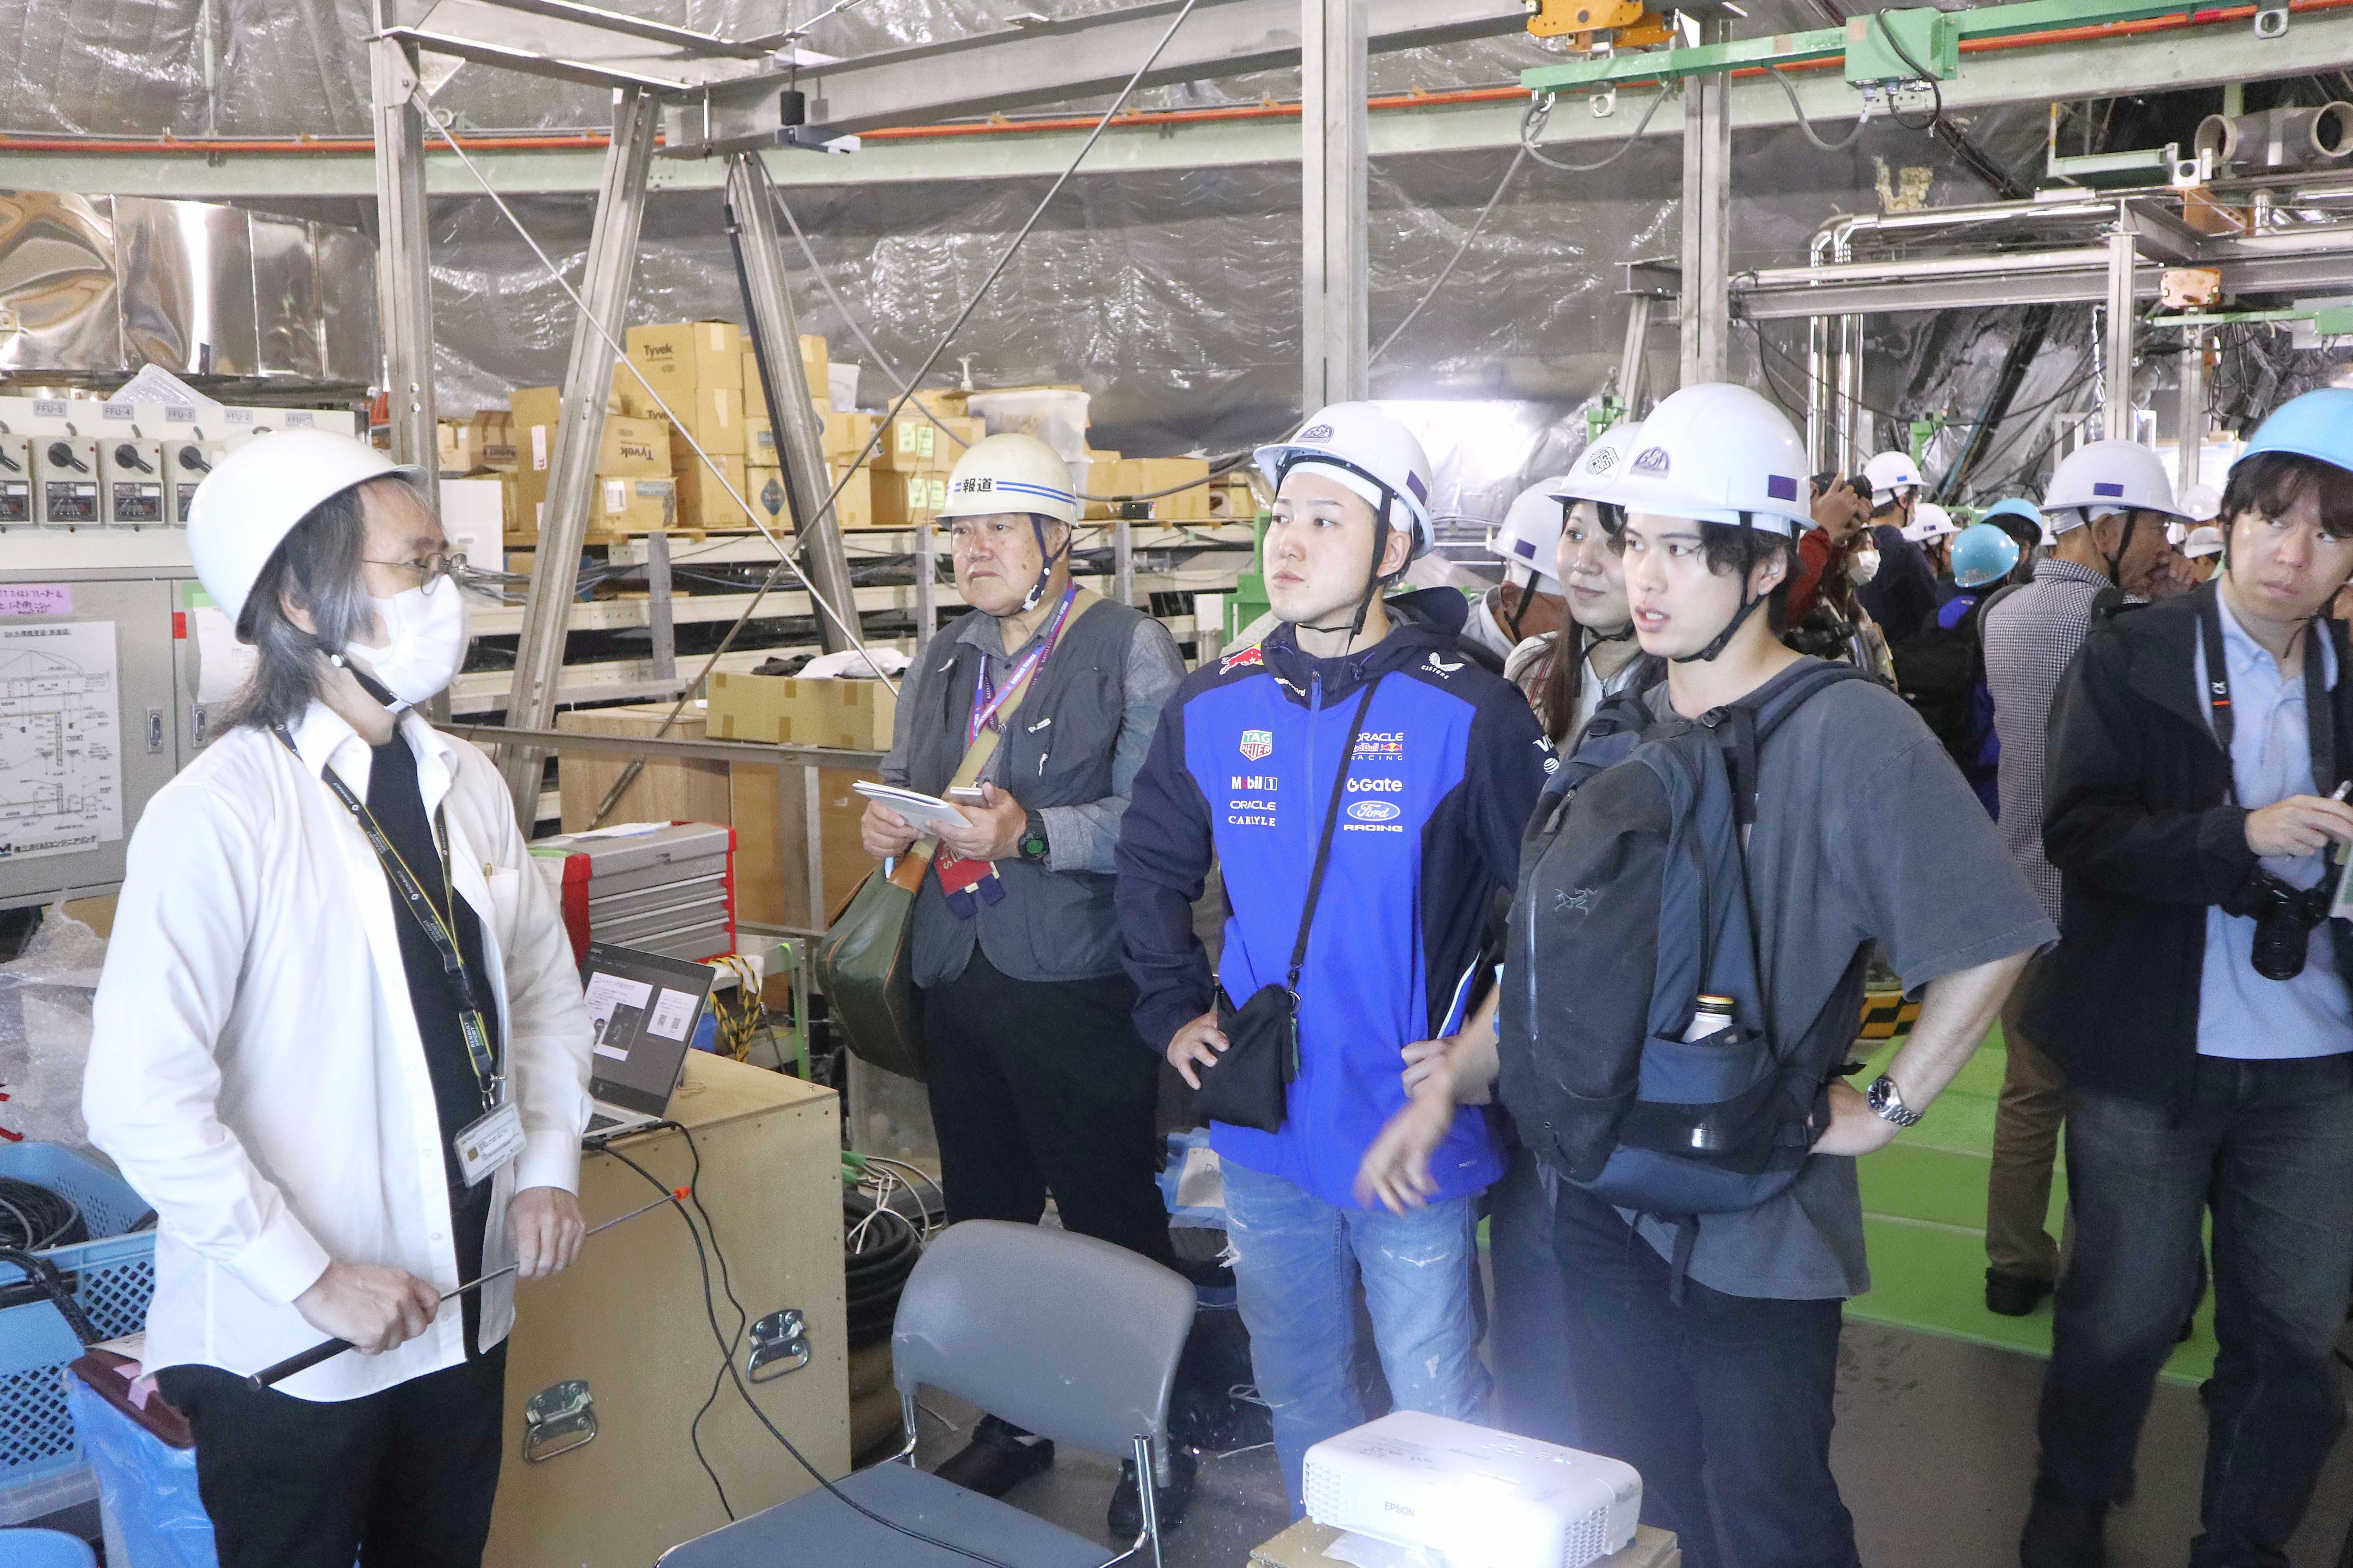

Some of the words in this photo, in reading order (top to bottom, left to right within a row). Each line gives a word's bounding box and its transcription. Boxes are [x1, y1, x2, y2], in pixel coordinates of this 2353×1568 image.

[644, 344, 672, 357] Tyvek
[105, 407, 130, 415] FFU-4
[227, 413, 250, 421] FFU-2
[621, 447, 654, 461] Tyvek
[963, 478, 992, 493] 報道
[1245, 732, 1271, 744] TAG
[1242, 744, 1270, 758] HEUER
[1231, 776, 1263, 789] Mobil
[1359, 778, 1403, 792] Gate
[332, 782, 354, 805] RENAULT
[1230, 800, 1277, 811] ORACLE
[1356, 803, 1390, 818] Ford
[1343, 824, 1403, 832] RACING
[464, 1022, 475, 1048] RENAULT
[470, 1026, 480, 1046] SPORT
[1384, 1502, 1415, 1517] EPSON
